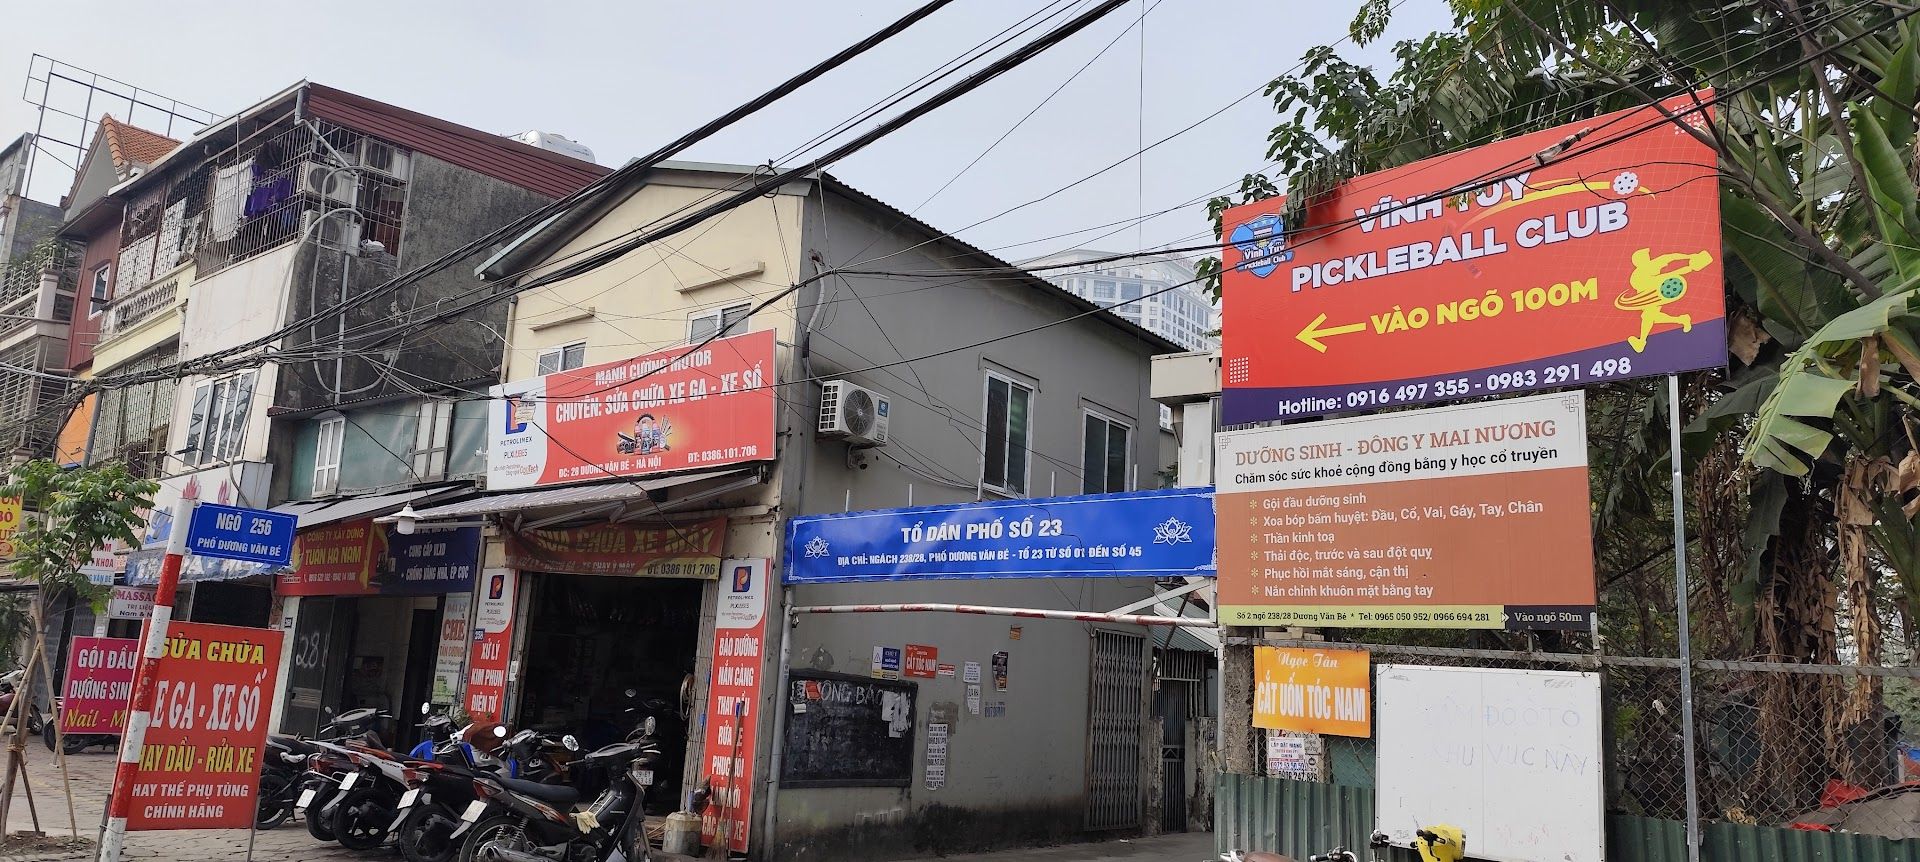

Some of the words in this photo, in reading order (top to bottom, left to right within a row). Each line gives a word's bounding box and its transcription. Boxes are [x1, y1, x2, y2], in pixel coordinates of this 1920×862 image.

[1354, 195, 1443, 233] VĨNH
[1291, 227, 1508, 291] PICKLEBALL
[1514, 201, 1629, 248] CLUB
[1370, 304, 1429, 336] VÀO
[1436, 288, 1504, 327] NGÕ
[1513, 277, 1599, 313] 100M
[595, 366, 627, 389] MẠNH
[629, 356, 668, 382] CƯỜNG
[670, 349, 711, 373] MOTOR
[555, 398, 602, 424] CHUYÊN:
[604, 387, 630, 416] SỬA
[631, 382, 666, 410] CHỮA
[668, 381, 685, 406] XE
[689, 378, 707, 403] GA
[720, 371, 739, 396] XE
[742, 359, 763, 392] SỐ
[1278, 394, 1342, 416] Hotline:
[1346, 388, 1390, 407] 0916
[1394, 384, 1428, 402] 497
[1434, 378, 1469, 397] 355
[1486, 369, 1537, 391] 0983
[1543, 365, 1581, 385] 291
[1590, 358, 1632, 379] 498
[500, 436, 533, 447] PETROLIMEX
[1235, 446, 1295, 466] DƯỠNG
[1299, 443, 1342, 460] SINH
[1357, 434, 1408, 455] ĐÔNG
[1411, 434, 1423, 450] Y
[1429, 428, 1470, 449] MAI
[1474, 420, 1557, 445] NƯƠNG
[604, 459, 619, 473] VĂN
[620, 457, 630, 472] BÉ
[636, 457, 647, 470] HÀ
[647, 455, 662, 471] NỘI
[687, 452, 700, 464] ĐT:
[701, 445, 757, 463] 0386.101.706
[1235, 472, 1265, 485] Chăm
[1268, 469, 1288, 482] sóc
[1291, 466, 1311, 480] sức
[1346, 462, 1375, 479] cộng
[1378, 457, 1410, 476] đồng
[1413, 455, 1446, 474] bằng
[1450, 459, 1458, 471] y
[1461, 453, 1487, 470] học
[1490, 448, 1507, 464] cổ
[1511, 445, 1557, 466] truyền
[1263, 498, 1282, 512] Gội
[1285, 496, 1302, 509] đầu
[1305, 494, 1340, 509] dưỡng
[1343, 493, 1367, 505] sinh
[216, 509, 242, 533] NGÕ
[250, 517, 271, 536] 256
[901, 520, 922, 544] TỔ
[925, 520, 962, 543] DÂN
[965, 515, 1003, 541] PHỐ
[1008, 513, 1035, 539] SỐ
[1038, 519, 1063, 537] 23
[197, 535, 217, 550] PHỐ
[217, 538, 249, 554] DƯƠNG
[249, 541, 269, 556] VĂN
[270, 542, 282, 557] BÉ
[325, 530, 333, 540] TY
[1264, 530, 1290, 544] Thần
[1292, 530, 1315, 543] kinh
[1317, 532, 1335, 545] toạ
[837, 556, 849, 569] ĐỊA
[851, 553, 868, 566] CHỈ:
[869, 551, 898, 566] NGÁCH
[899, 551, 926, 565] 238/28,
[928, 547, 948, 562] PHỐ
[948, 548, 977, 562] DƯƠNG
[978, 547, 997, 561] VĂN
[997, 546, 1009, 560] BÉ
[1018, 546, 1030, 560] TỔ
[1031, 549, 1043, 560] 23
[1044, 546, 1057, 559] TỪ
[1058, 545, 1072, 559] SỐ
[1088, 544, 1109, 558] ĐẾN
[1111, 544, 1126, 557] SỐ
[1128, 545, 1142, 557] 45
[1290, 548, 1312, 563] độc,
[1315, 547, 1344, 561] trước
[1347, 548, 1361, 559] và
[1363, 549, 1384, 559] sau
[1386, 545, 1407, 560] đột
[661, 563, 681, 576] 0386
[682, 563, 698, 577] 101
[699, 563, 716, 577] 706
[1264, 567, 1290, 581] Phục
[1293, 565, 1309, 579] hồi
[1310, 565, 1334, 578] mắt
[1336, 566, 1367, 581] sáng,
[1369, 566, 1390, 580] cận
[1392, 565, 1408, 579] thị
[1246, 612, 1251, 621] 2
[1252, 612, 1266, 623] ngõ
[1267, 612, 1292, 622] 238/28
[1293, 611, 1315, 623] Dương
[1317, 611, 1332, 621] Văn
[1334, 610, 1347, 621] Bé
[1358, 612, 1372, 621] Tel:
[1374, 612, 1392, 622] 0965
[1394, 612, 1411, 622] 050
[1413, 612, 1432, 623] 952/
[1434, 612, 1455, 622] 0966
[1457, 612, 1473, 622] 694
[1474, 612, 1490, 622] 281
[1514, 611, 1533, 623] Vào
[1535, 611, 1555, 625] ngõ
[1557, 612, 1583, 623] 50m
[481, 637, 491, 660] XỬ
[491, 639, 501, 661] LÝ
[719, 632, 734, 657] BẢO
[734, 633, 759, 658] DƯỠNG
[78, 646, 104, 672] GỘI
[926, 659, 937, 672] NAM
[70, 677, 107, 700] DƯỠNG
[470, 668, 485, 685] KIM
[485, 669, 504, 687] PHUN
[1257, 670, 1278, 715] CẮT
[1280, 676, 1304, 718] UỐN
[1306, 677, 1331, 720] TÓC
[1335, 688, 1366, 722] NAM
[161, 779, 186, 797] THẾ
[187, 783, 213, 801] PHỤ
[217, 781, 249, 797] TÙNG
[144, 802, 186, 819] CHÍNH
[187, 803, 224, 819] HÃNG
